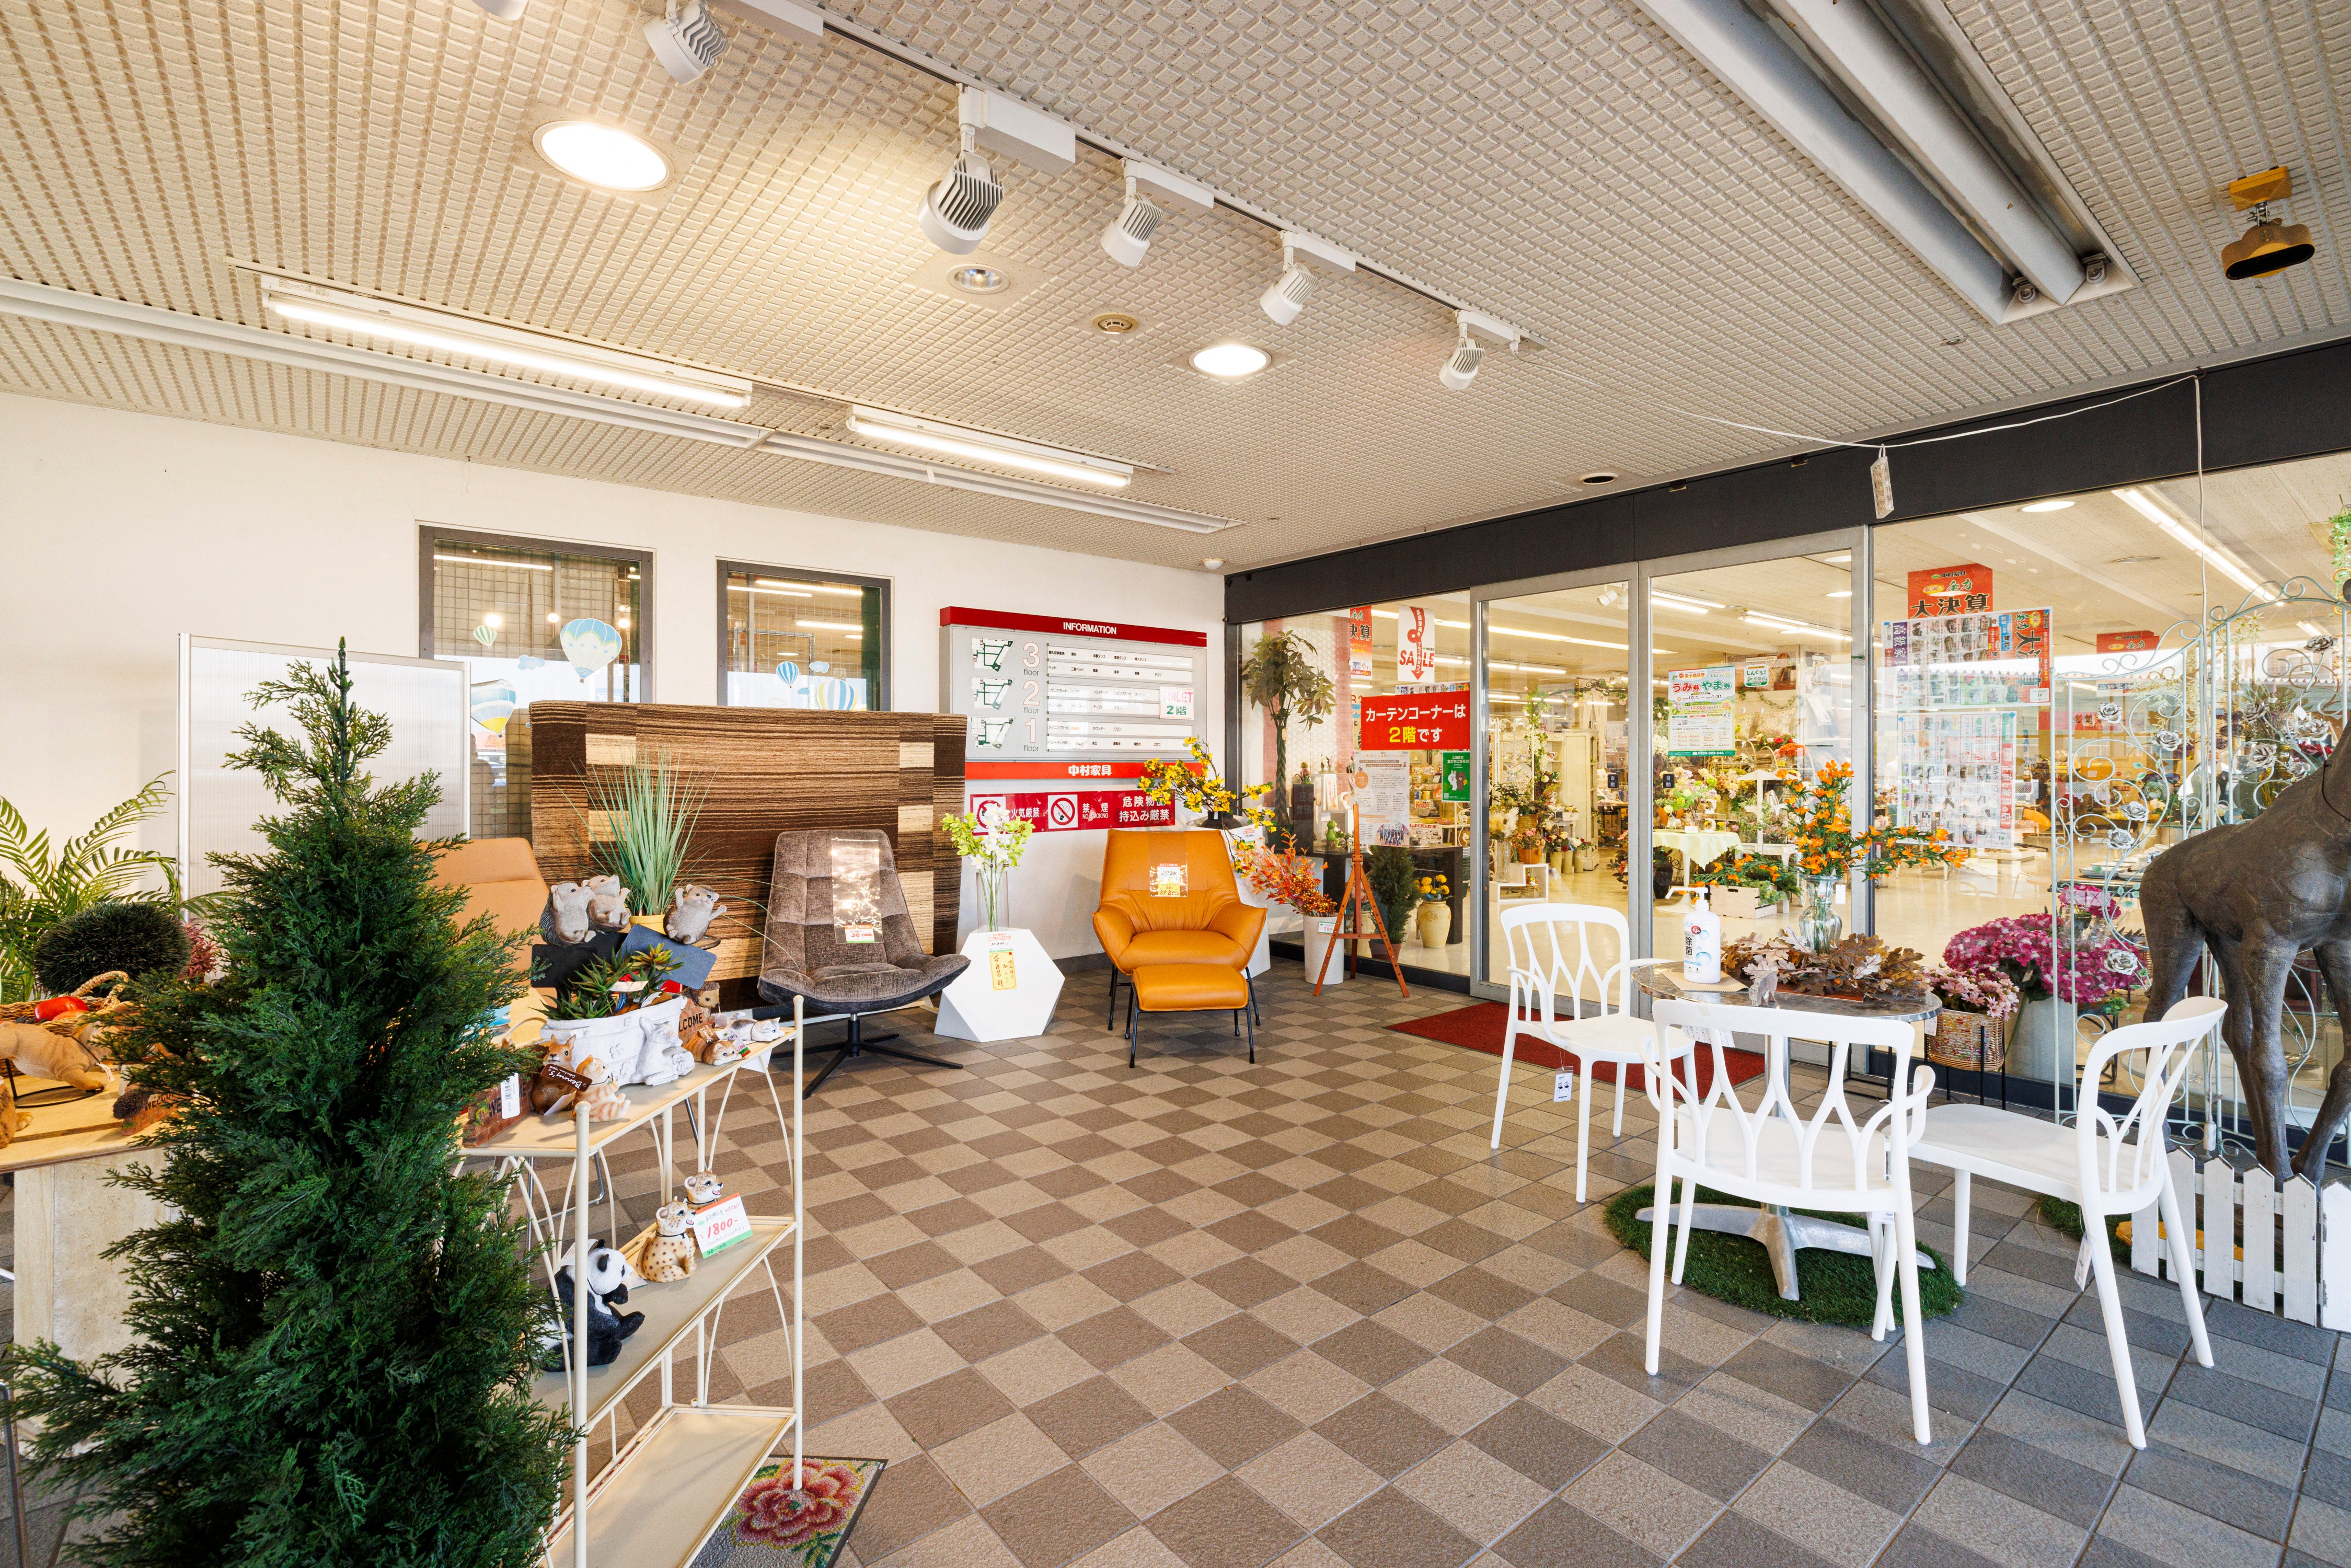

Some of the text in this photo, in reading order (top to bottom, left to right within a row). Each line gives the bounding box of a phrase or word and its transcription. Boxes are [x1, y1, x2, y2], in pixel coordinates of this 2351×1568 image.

[1947, 579, 1973, 591] 全力
[1910, 593, 1990, 619] 大決算
[1352, 610, 1364, 621] 全力
[1063, 621, 1117, 635] INFORMATION
[2126, 641, 2146, 650] 全力
[1022, 642, 1041, 668] 3
[1399, 650, 1435, 667] SALE
[1023, 680, 1041, 706] 2
[1672, 680, 1732, 693] うみ券 やま券
[1161, 691, 1193, 704] TOILET
[1166, 705, 1187, 716] 2階
[1366, 704, 1466, 722] カーテンコーナーは
[1024, 718, 1036, 743] 1
[1389, 726, 1443, 743] 2階です
[1068, 765, 1112, 776] 中村家具
[1610, 776, 1616, 787] 自動
[1665, 775, 1672, 787] 自動
[2001, 764, 2012, 825] 正直な家具の店!
[1011, 806, 1040, 819] 火気厳禁
[1119, 809, 1170, 822] 持込み厳禁
[1685, 936, 1693, 956] 除菌
[549, 1070, 583, 1089] Benny's
